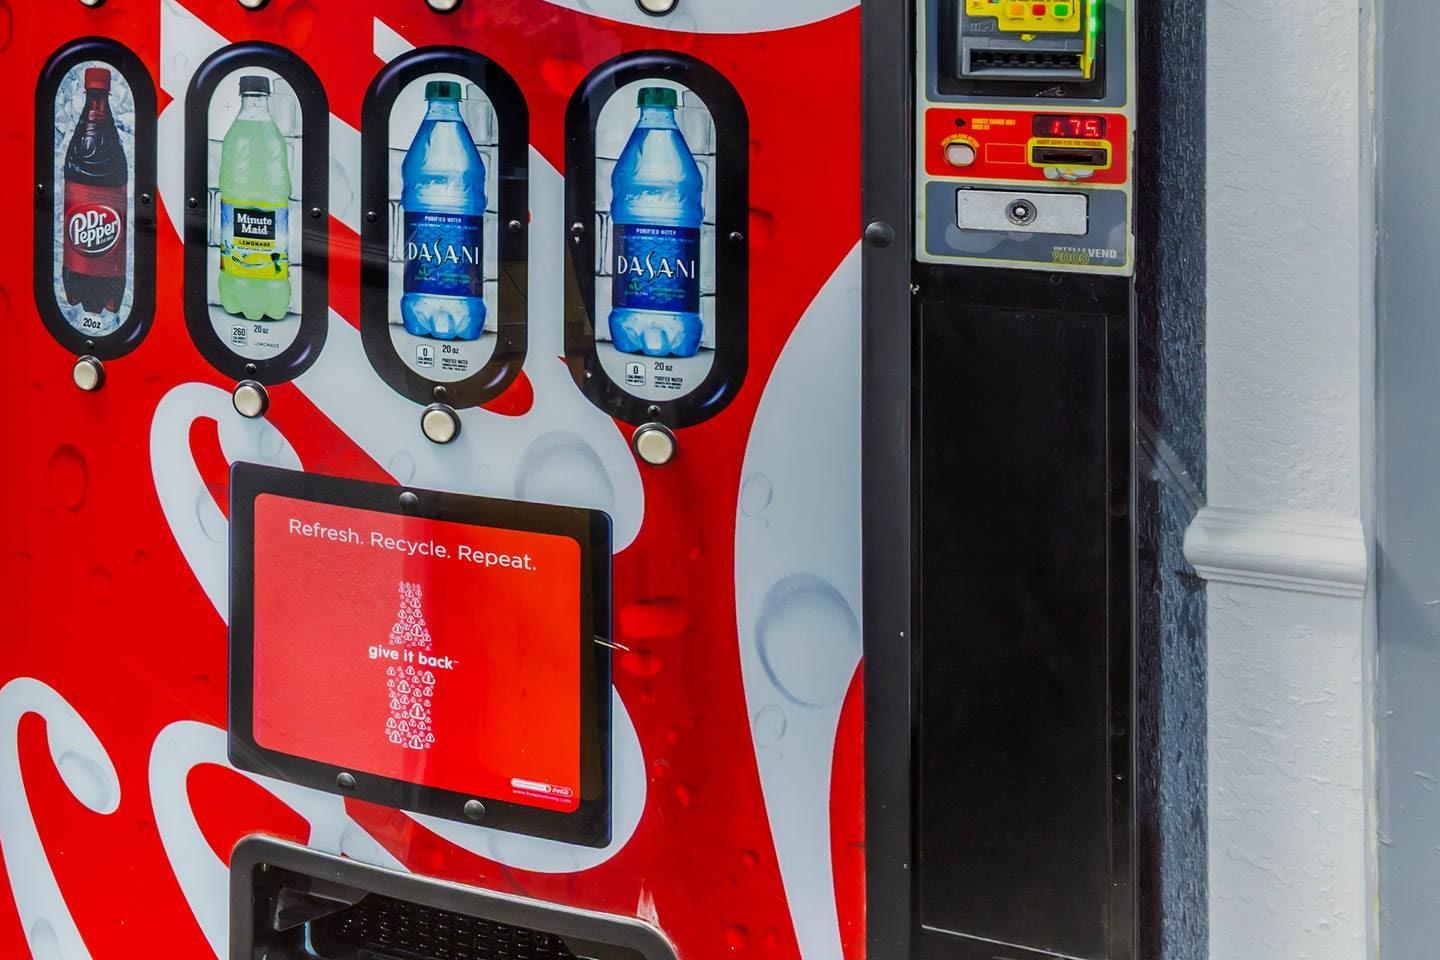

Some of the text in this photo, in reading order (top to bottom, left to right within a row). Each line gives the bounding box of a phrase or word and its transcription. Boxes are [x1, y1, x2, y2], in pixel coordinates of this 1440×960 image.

[86, 210, 107, 230] Dr
[236, 213, 272, 226] Minute
[70, 212, 118, 247] Pepper
[241, 223, 269, 235] Maid
[238, 240, 271, 248] LEMONADE
[408, 239, 479, 266] DASANI
[617, 250, 695, 280] DASANI
[233, 327, 246, 336] 260
[253, 324, 262, 334] 20
[422, 347, 428, 357] 0
[442, 344, 451, 353] 20
[633, 365, 639, 375] 0
[654, 361, 664, 371] 20
[288, 518, 538, 572] Refresh. Recycle. Repeat.
[368, 643, 454, 671] give it back
